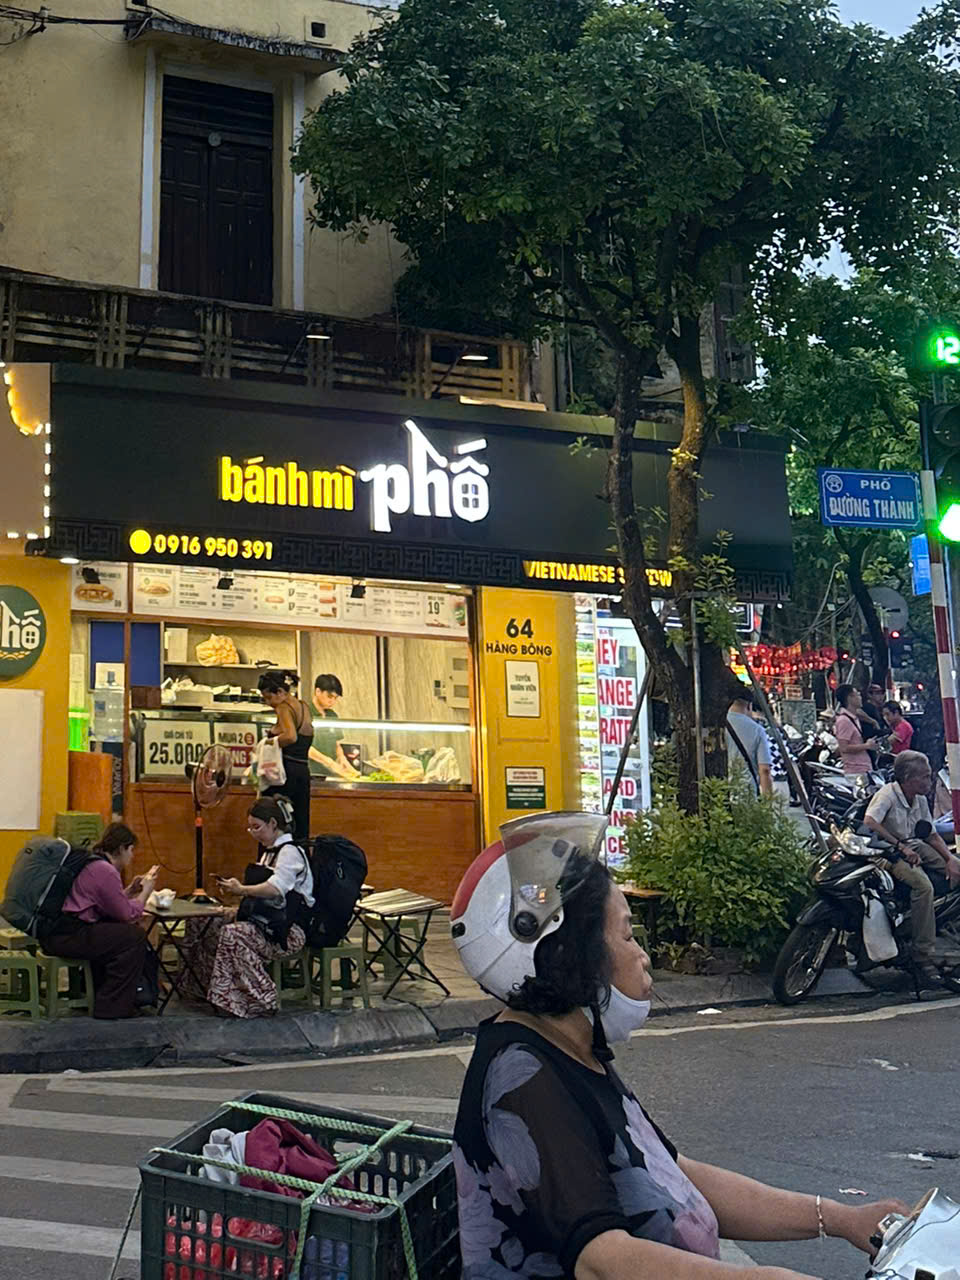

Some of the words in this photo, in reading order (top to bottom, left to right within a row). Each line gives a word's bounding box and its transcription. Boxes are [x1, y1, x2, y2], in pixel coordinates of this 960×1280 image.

[936, 336, 960, 364] 12
[360, 419, 490, 533] phố
[860, 477, 892, 491] PHỐ
[829, 492, 871, 518] ĐƯỜNG
[872, 495, 915, 520] THÀNH
[154, 533, 202, 556] 0916
[204, 536, 239, 559] 950
[241, 539, 274, 561] 391
[523, 560, 616, 584] VIETNAMESE
[506, 618, 534, 639] 64
[486, 640, 518, 655] HÀNG
